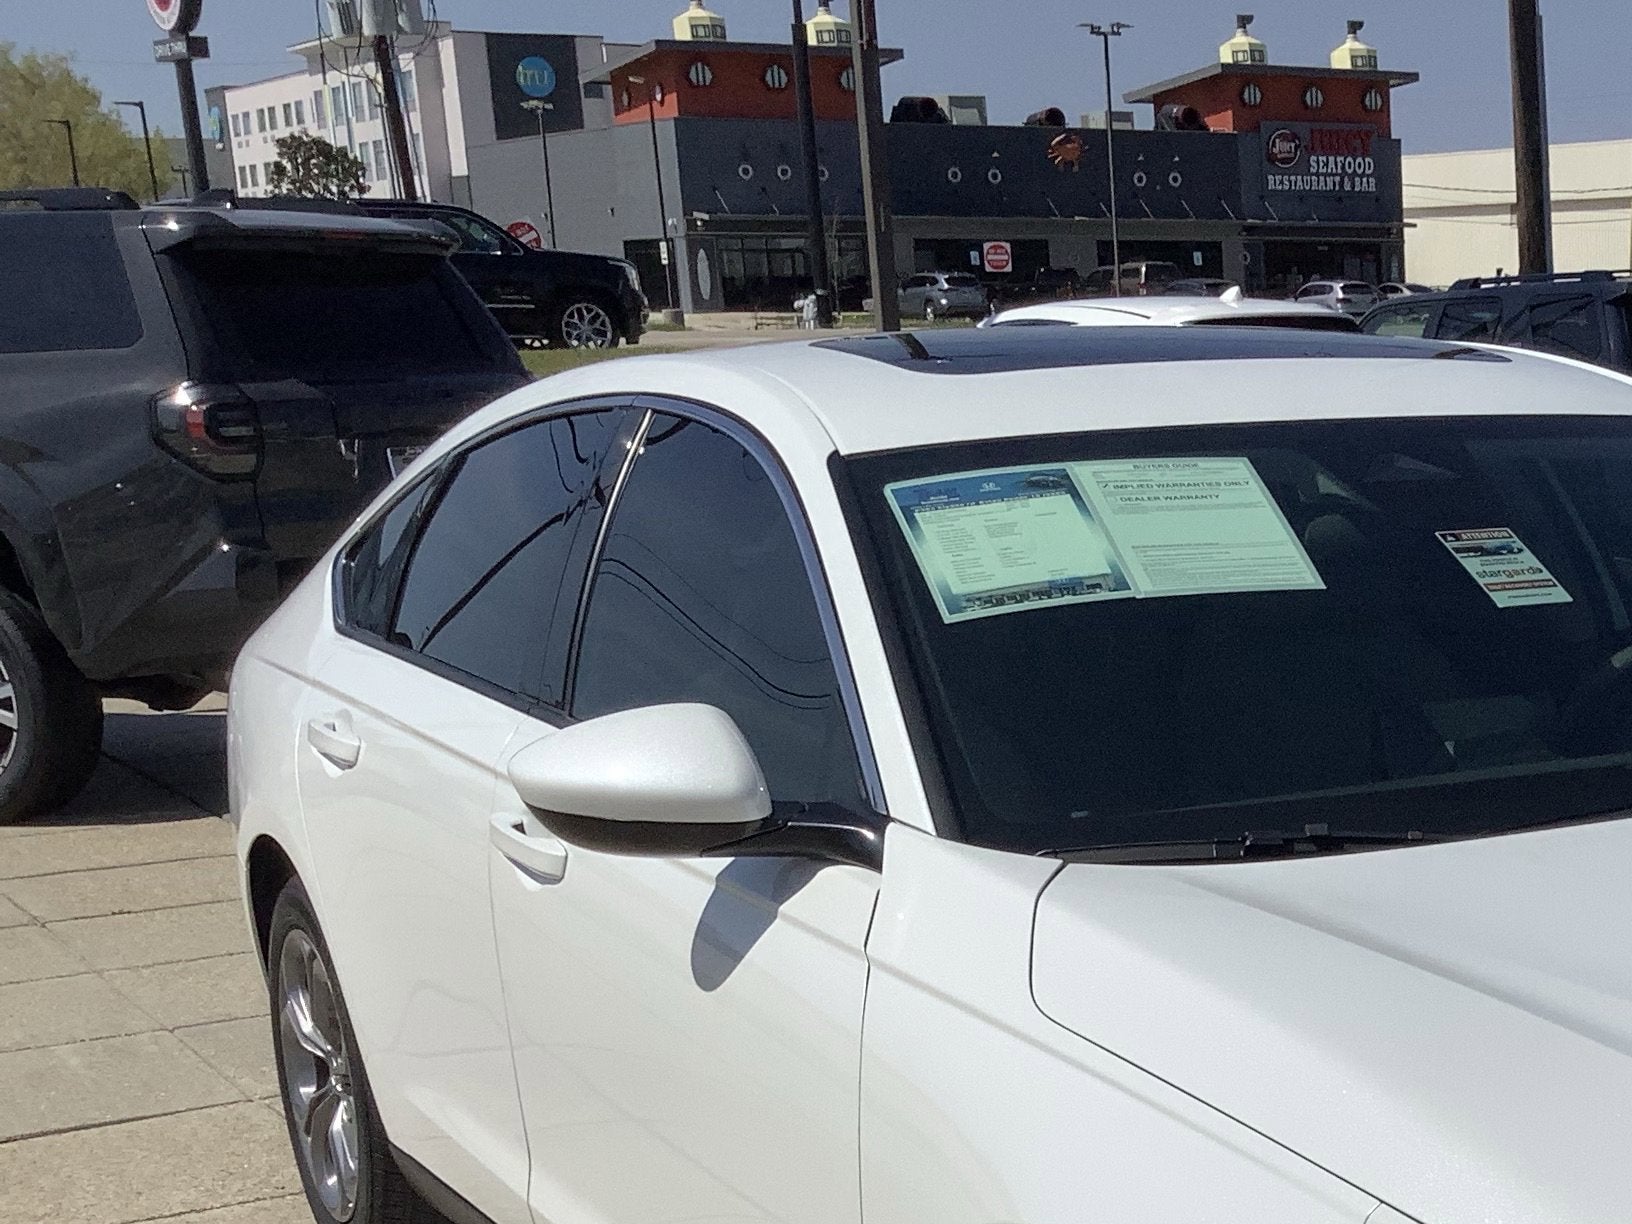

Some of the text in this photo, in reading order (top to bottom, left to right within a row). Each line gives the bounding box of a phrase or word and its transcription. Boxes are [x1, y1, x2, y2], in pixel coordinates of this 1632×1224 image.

[1309, 155, 1374, 174] SEAFOOD
[1267, 174, 1377, 192] RESTAURANT & BAR
[1113, 482, 1154, 490] IMPLIED
[1156, 481, 1222, 489] WARRANTIES
[1120, 495, 1161, 503] DEALER
[1461, 530, 1510, 540] ATTENTION
